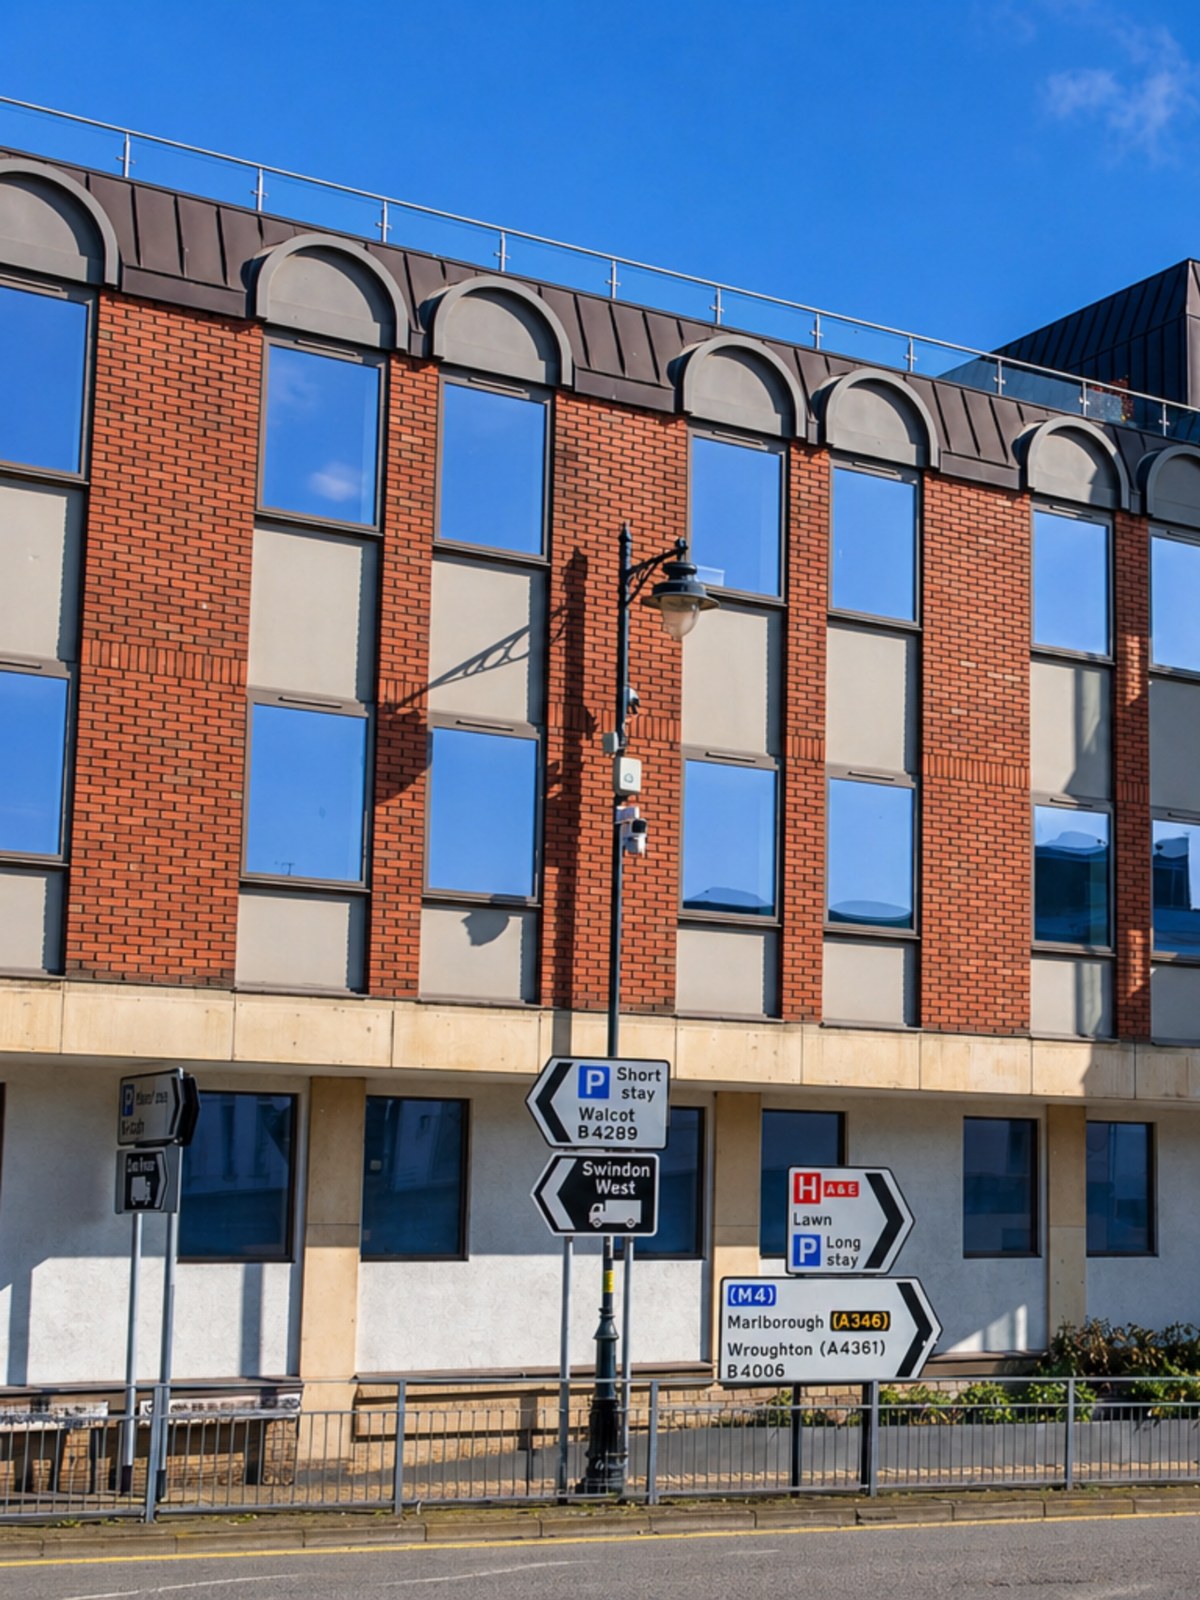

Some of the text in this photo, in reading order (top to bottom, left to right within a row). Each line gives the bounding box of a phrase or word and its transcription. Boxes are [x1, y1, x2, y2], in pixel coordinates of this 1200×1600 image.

[586, 1067, 661, 1095] P Short
[621, 1086, 656, 1102] stay
[579, 1107, 635, 1122] Walcot
[582, 1161, 650, 1177] Swindon
[595, 1179, 636, 1194] West
[799, 1175, 817, 1200] H
[793, 1212, 832, 1226] Lawn
[800, 1236, 861, 1263] P Long
[826, 1255, 858, 1269] stay
[729, 1287, 774, 1304] (M4)
[727, 1312, 889, 1332] Marlborough (A346)
[727, 1341, 886, 1359] Wroughton (A4361)
